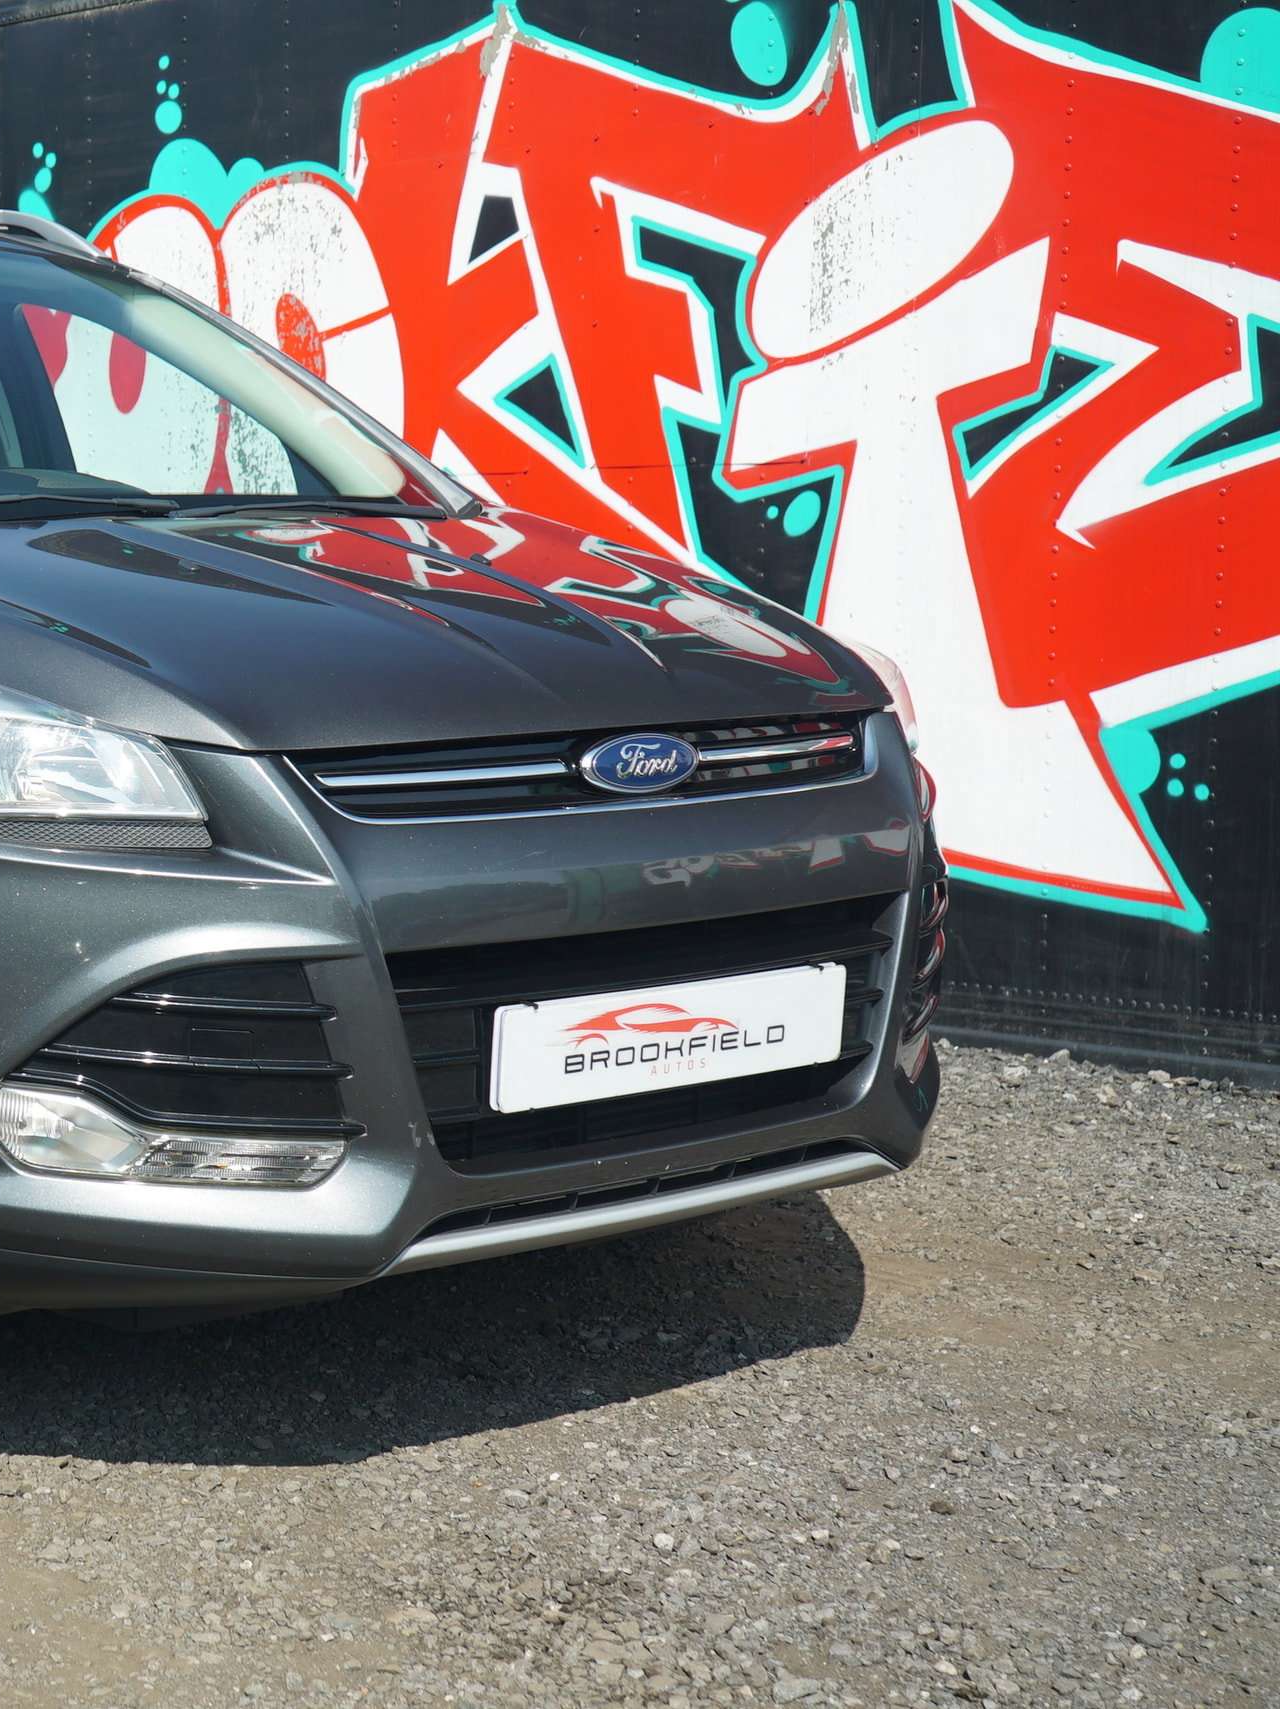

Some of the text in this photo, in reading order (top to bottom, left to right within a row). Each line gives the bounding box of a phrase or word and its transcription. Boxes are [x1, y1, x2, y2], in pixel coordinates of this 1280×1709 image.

[616, 742, 678, 779] Ford
[565, 1024, 785, 1074] BROOKFIELD
[650, 1059, 707, 1076] AUTOS
